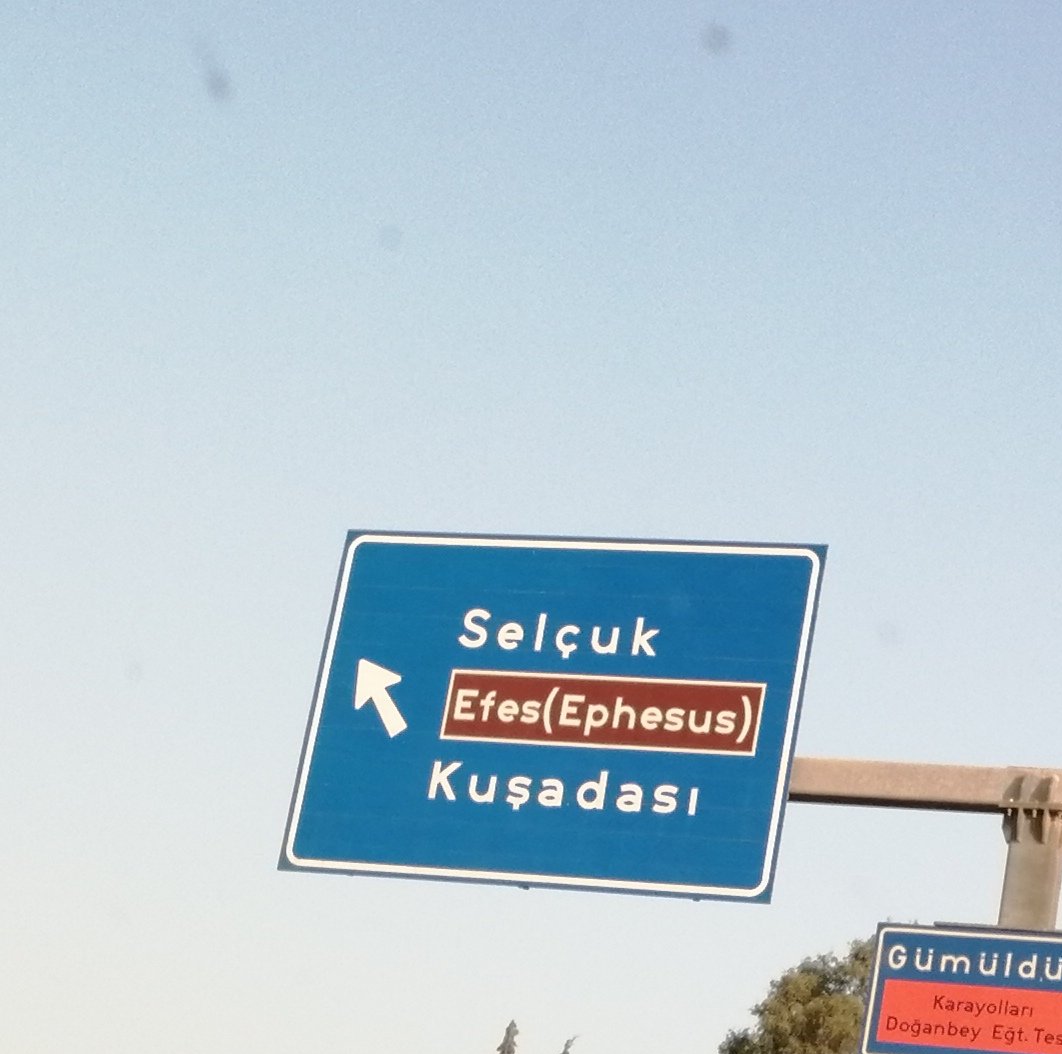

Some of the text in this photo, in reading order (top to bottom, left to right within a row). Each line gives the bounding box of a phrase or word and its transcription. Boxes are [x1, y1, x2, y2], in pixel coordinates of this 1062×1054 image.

[458, 608, 660, 659] Selçuk
[453, 687, 754, 744] Efes(Ephesus)
[428, 761, 699, 816] Kuşadası
[885, 1015, 981, 1042] Doğanbey
[992, 1024, 1029, 1046] Eğt.
[933, 994, 1034, 1018] Karayolları
